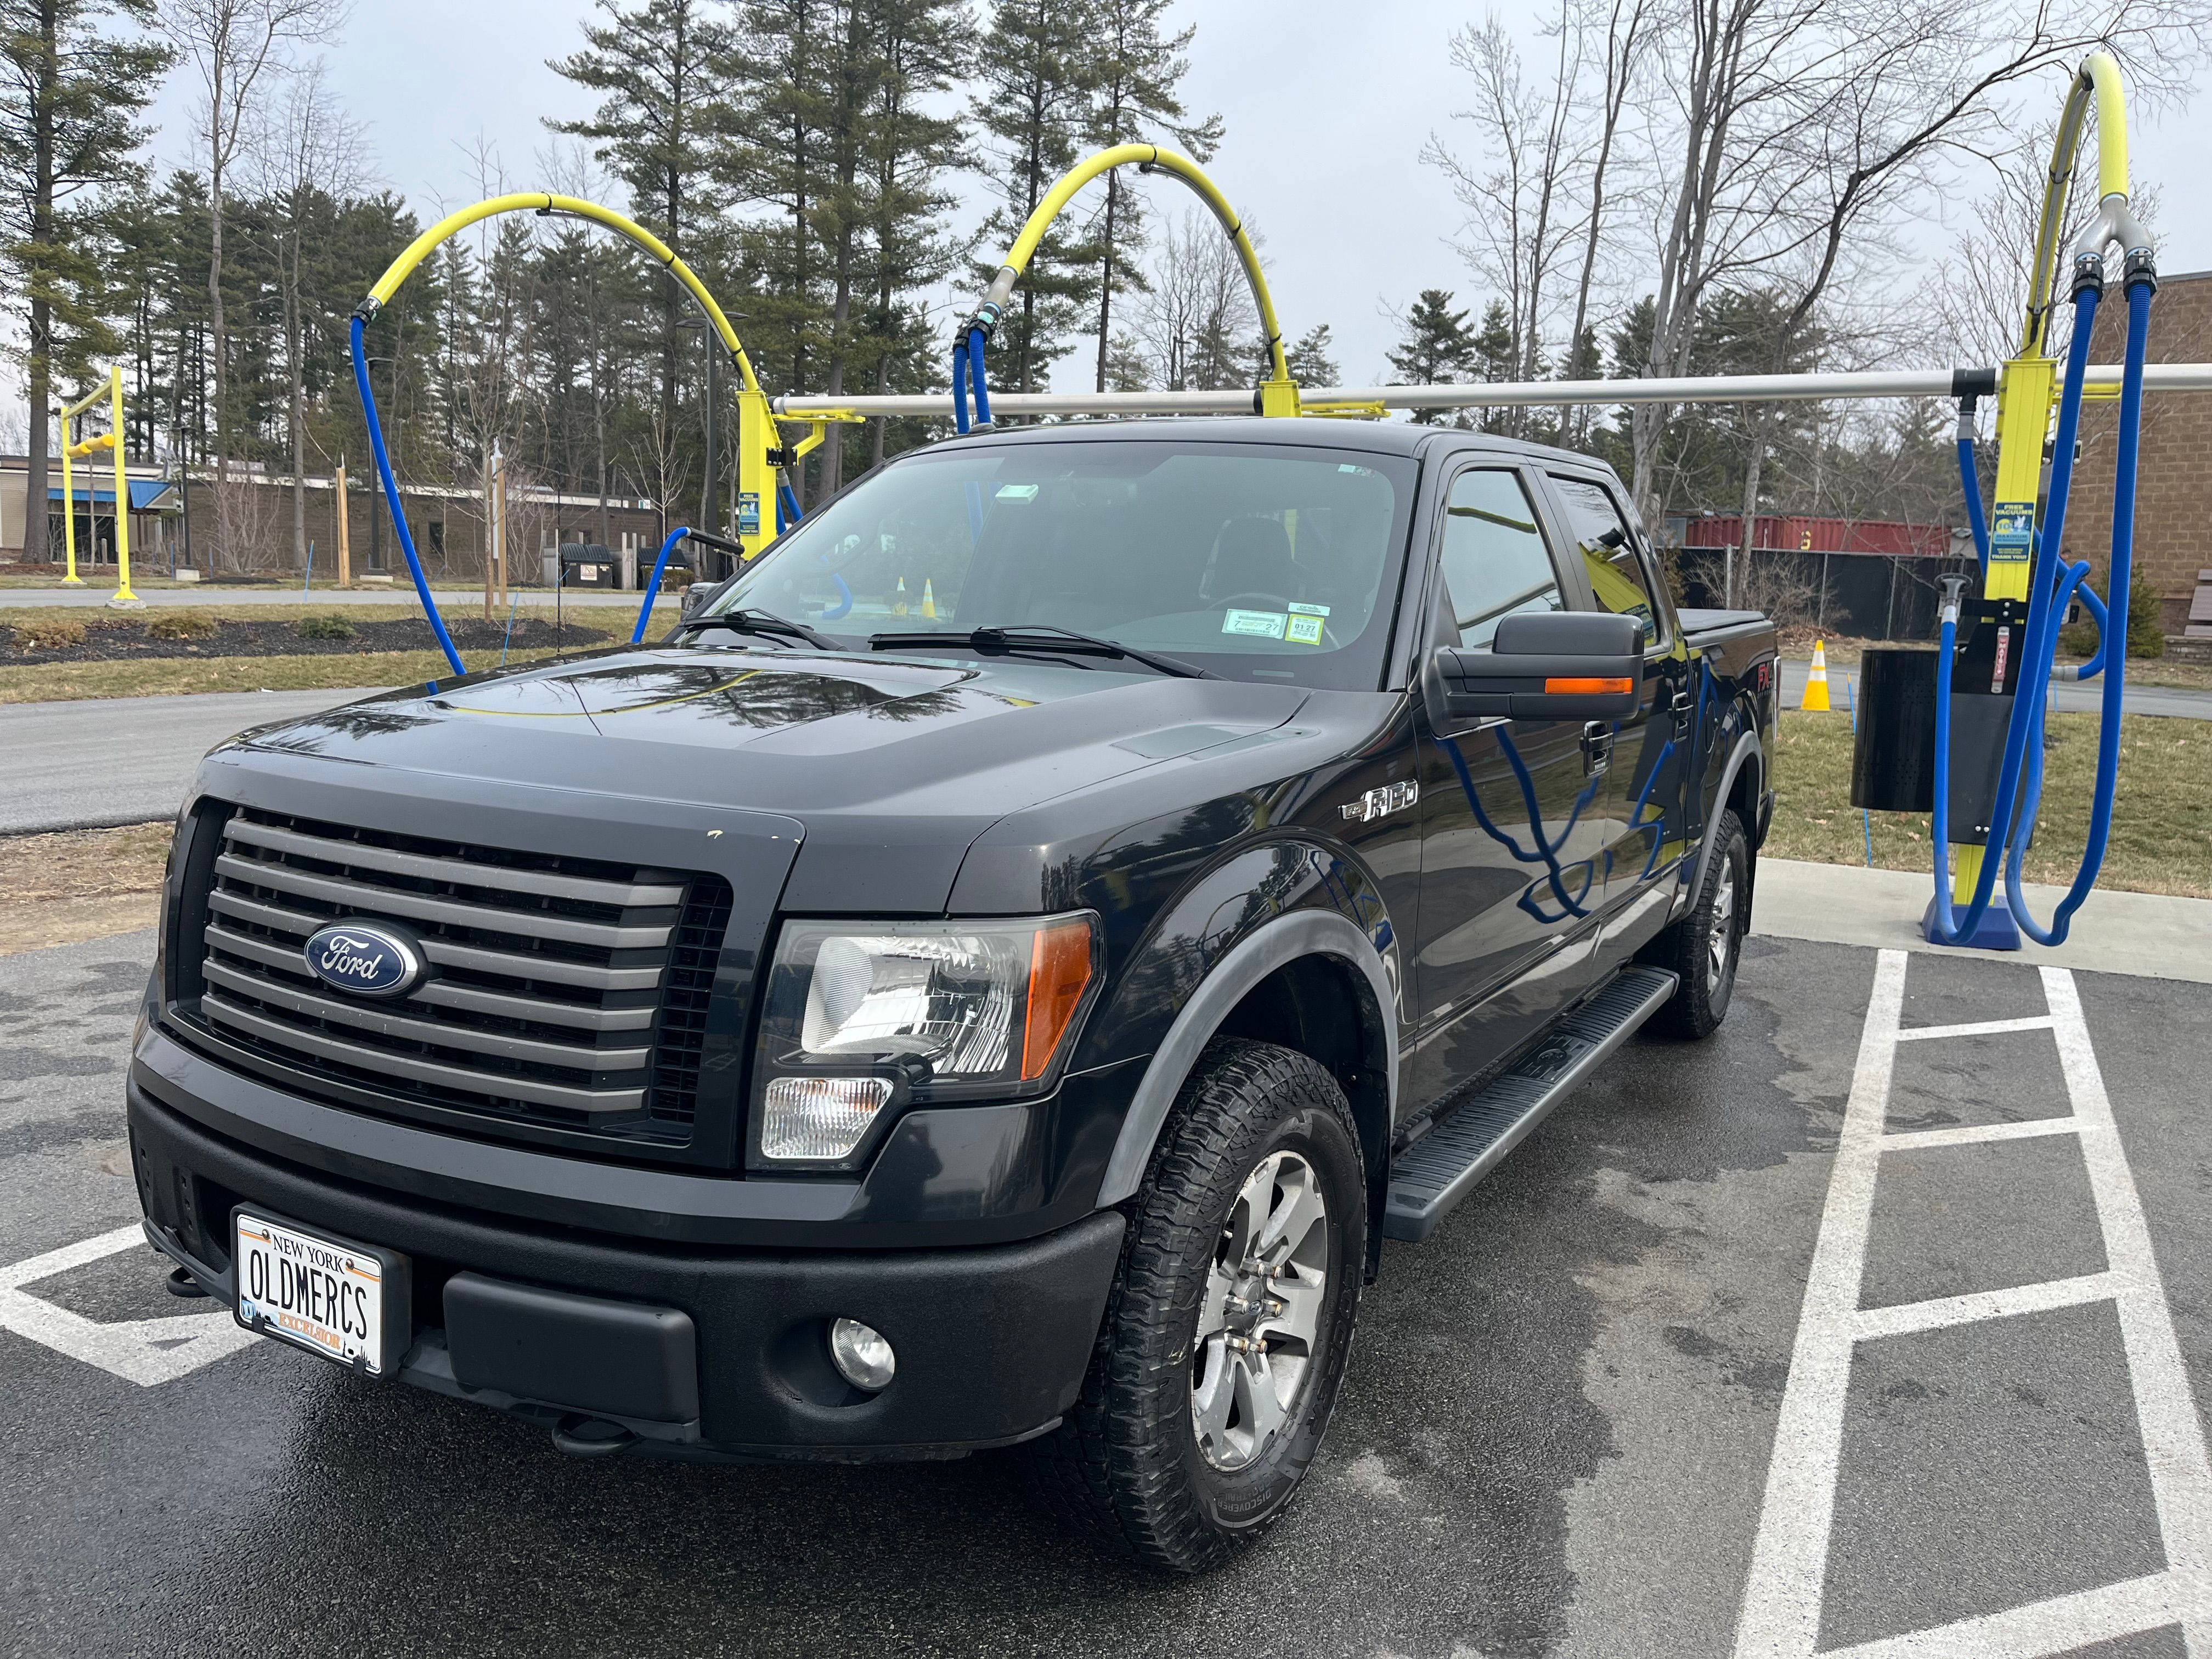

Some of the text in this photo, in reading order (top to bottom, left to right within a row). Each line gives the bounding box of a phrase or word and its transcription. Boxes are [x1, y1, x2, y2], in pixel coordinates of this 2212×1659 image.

[321, 935, 383, 979] Ford
[272, 1234, 345, 1275] NEW YORK
[250, 1249, 366, 1340] OLDMERCS
[279, 1312, 340, 1350] EXCELSIOR
